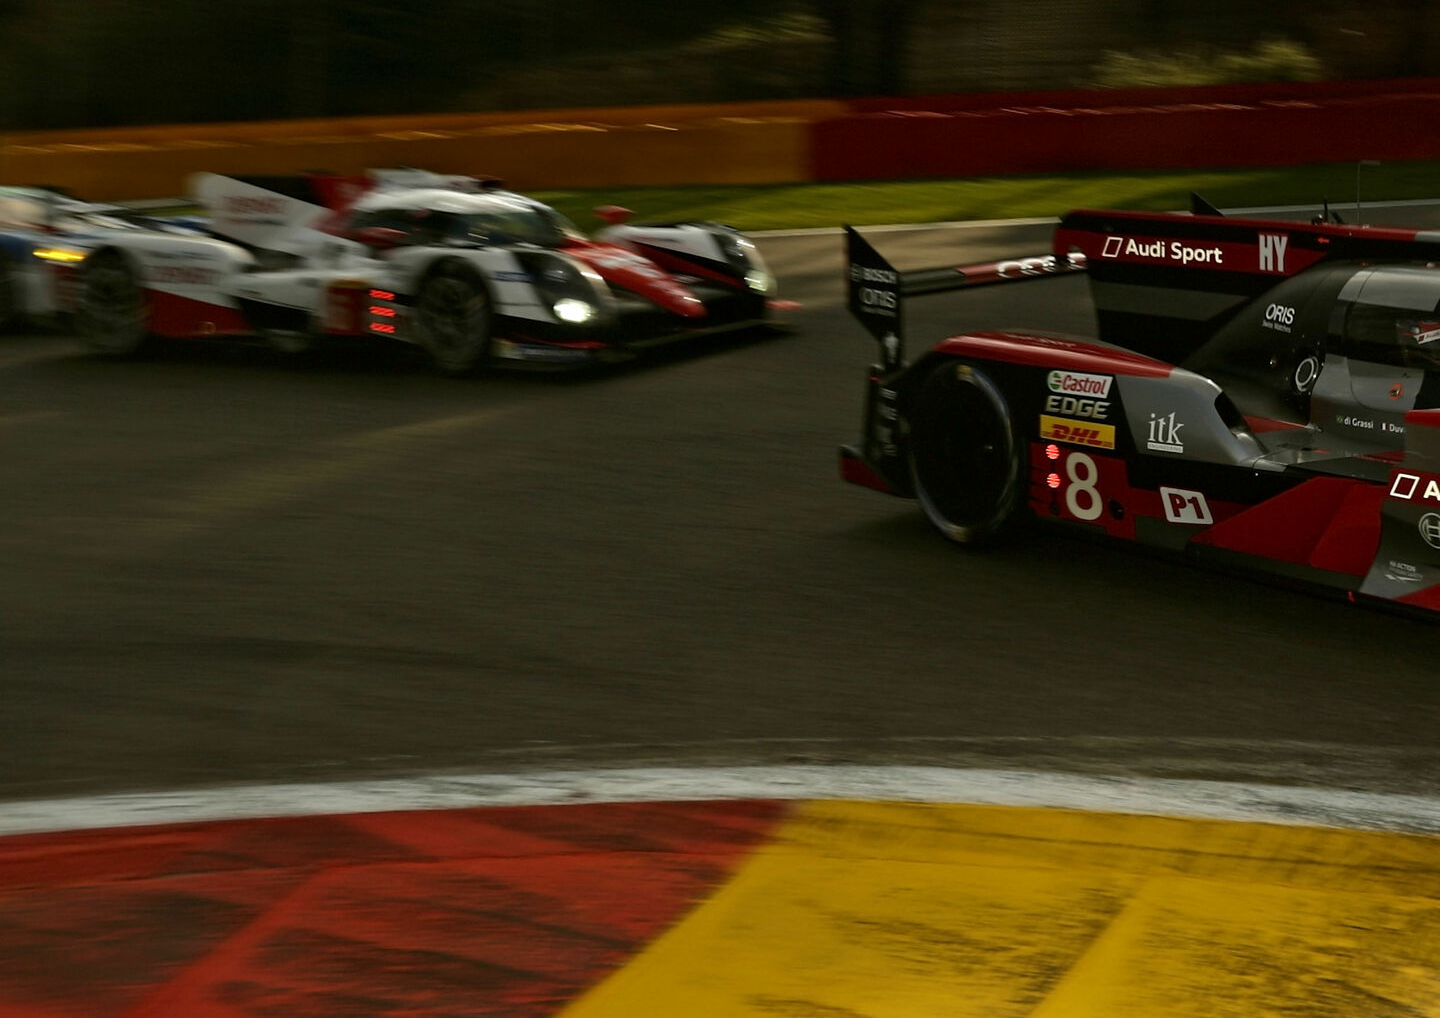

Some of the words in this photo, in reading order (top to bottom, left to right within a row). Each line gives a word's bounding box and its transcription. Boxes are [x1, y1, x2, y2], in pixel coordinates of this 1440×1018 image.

[1125, 238, 1166, 258] Audi
[1170, 241, 1223, 265] Sport
[1258, 234, 1288, 272] HY
[1265, 303, 1296, 325] ORIS
[1061, 374, 1108, 395] Castrol
[1045, 395, 1112, 420] EDGE
[1051, 424, 1103, 445] DHL
[1147, 411, 1185, 445] itk
[1352, 417, 1374, 429] Grassi
[1389, 423, 1405, 433] Duv
[1065, 451, 1104, 521] 8
[1168, 492, 1205, 520] P1
